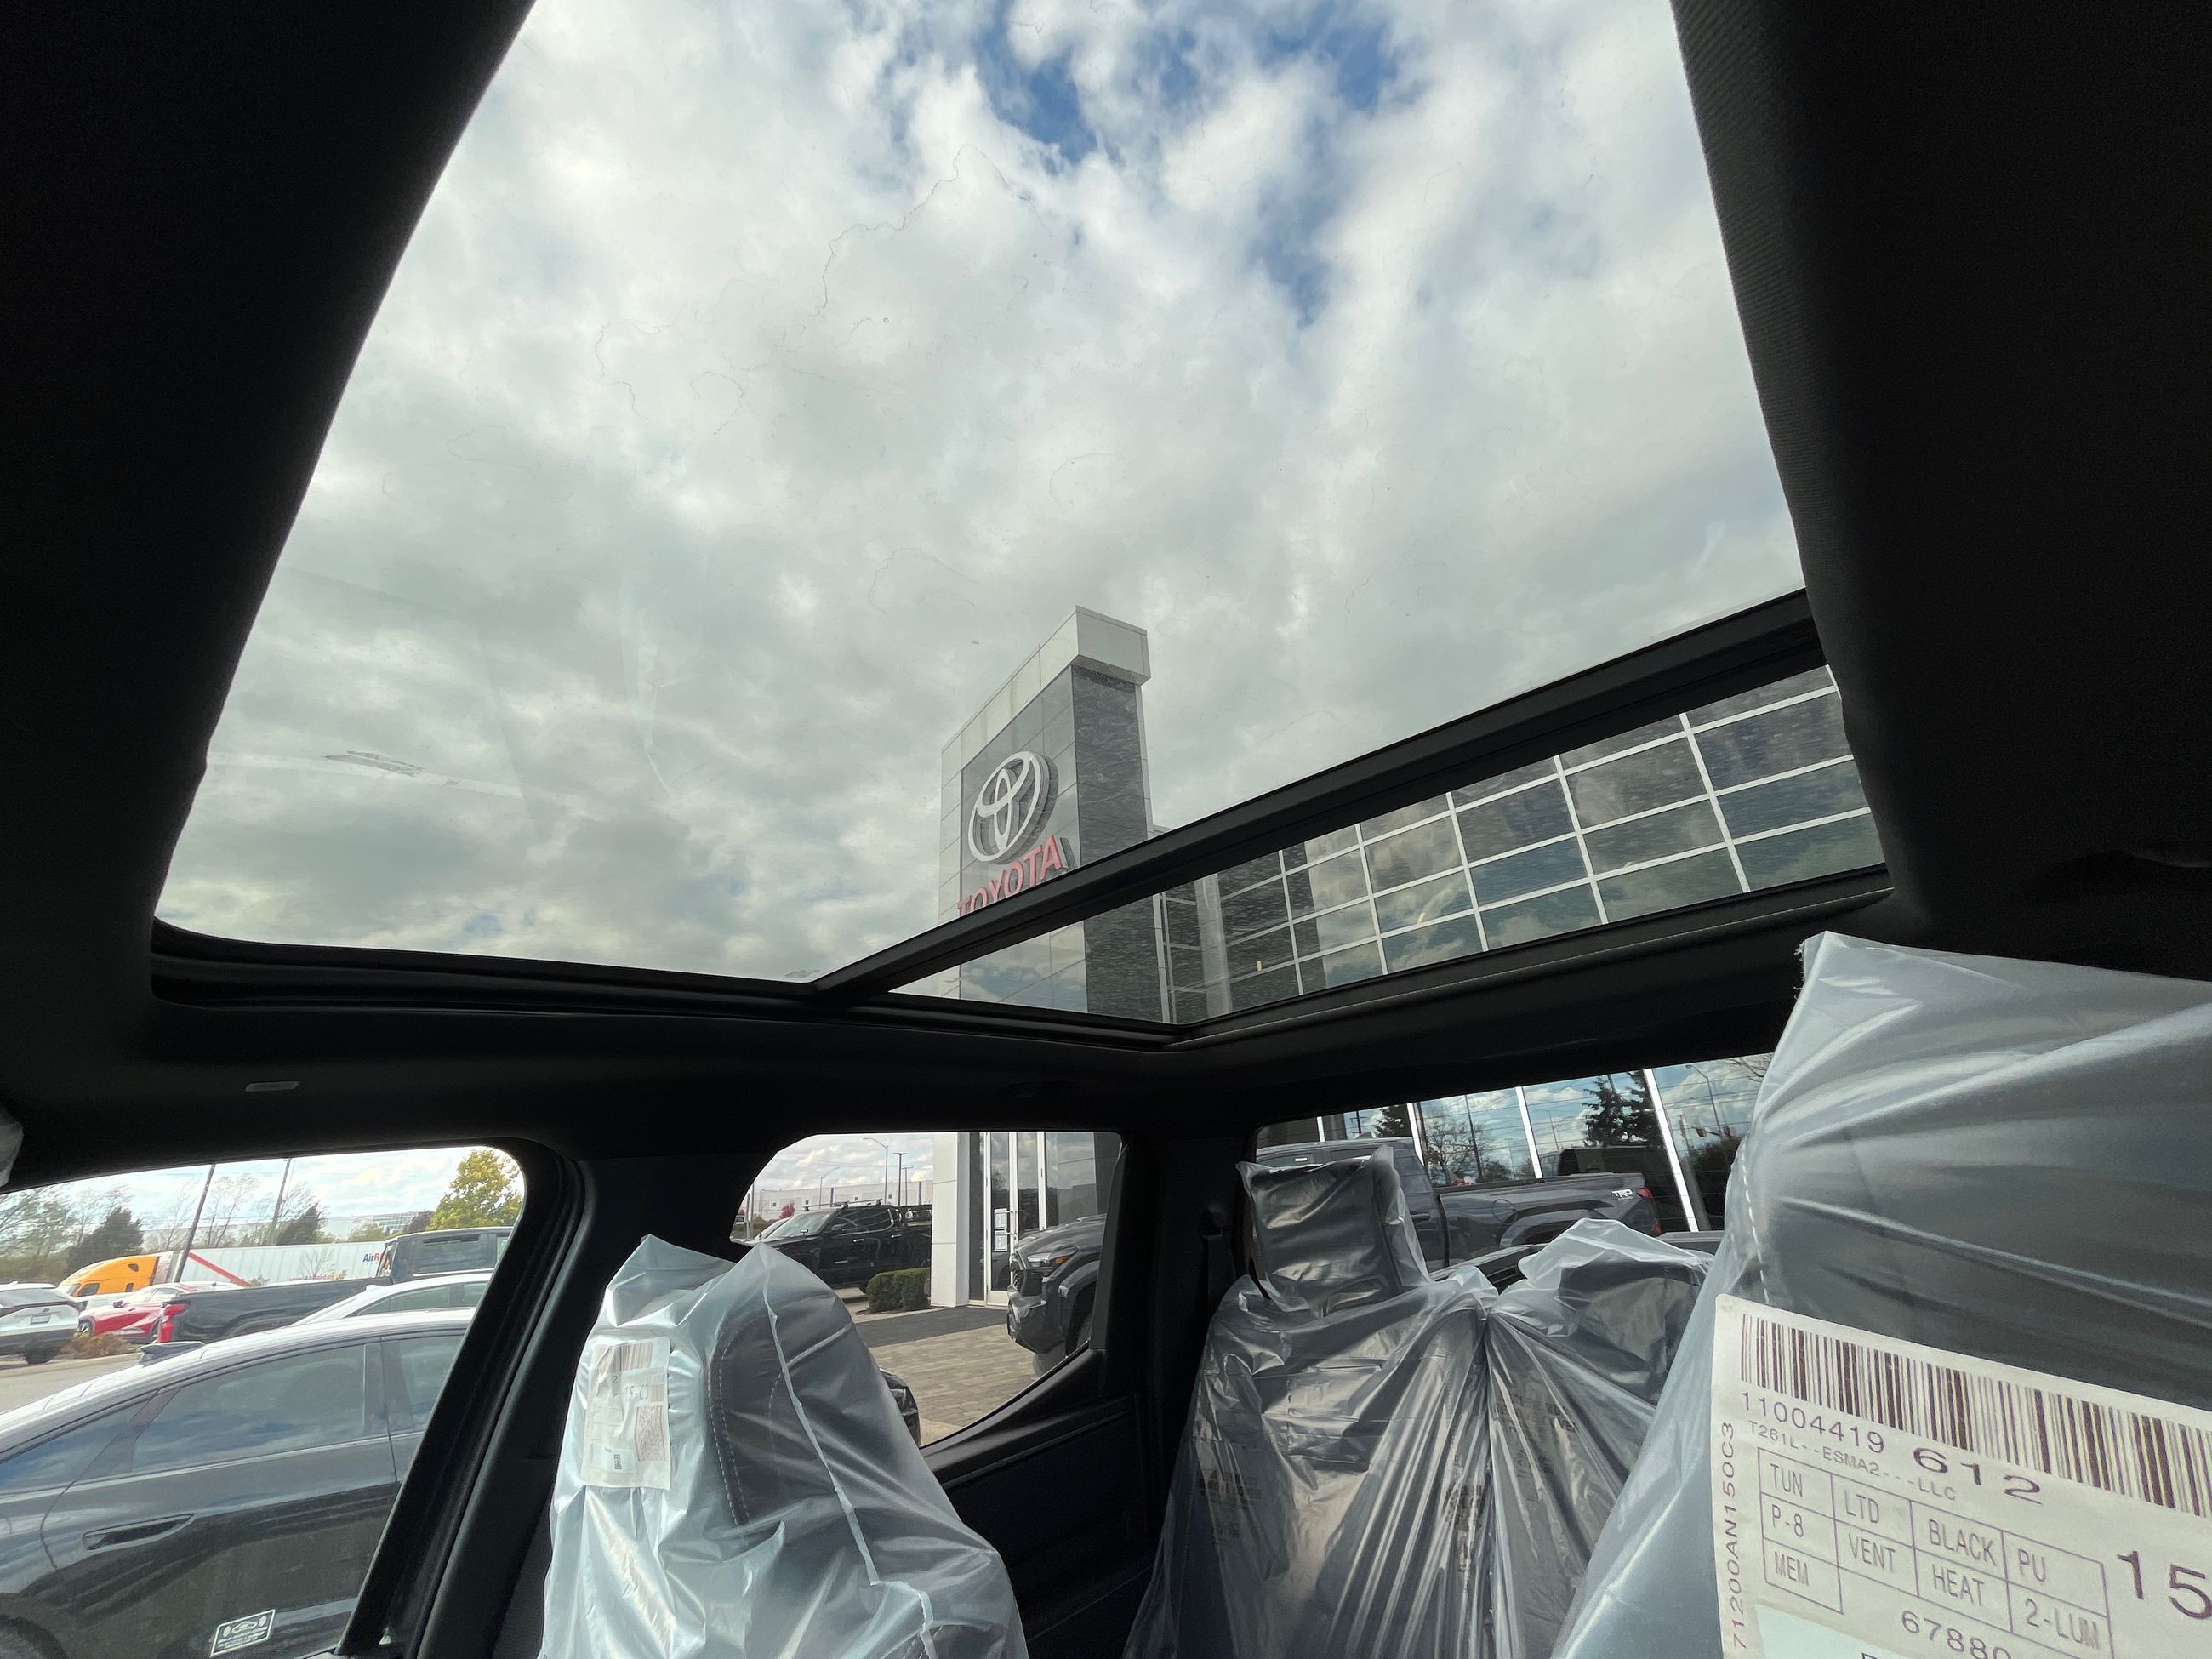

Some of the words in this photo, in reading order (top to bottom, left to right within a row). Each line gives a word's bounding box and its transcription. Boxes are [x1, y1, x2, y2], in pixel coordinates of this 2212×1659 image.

[957, 835, 1063, 917] TOYOTA
[1742, 1391, 1884, 1454] 11004419
[1913, 1447, 2043, 1505] 612
[1770, 1462, 1803, 1497] TUN
[1771, 1503, 1804, 1537] P-8
[1844, 1489, 1879, 1524] LTD
[1721, 1422, 1747, 1649] 71200AN150C3
[1848, 1532, 1896, 1573] VENT
[1928, 1519, 1998, 1567] BLACK
[1774, 1550, 1810, 1587] MEM
[1931, 1563, 1985, 1606] HEAT
[2017, 1548, 2047, 1583] PU
[2116, 1550, 2212, 1620] 15
[2024, 1598, 2100, 1650] 2-LUM
